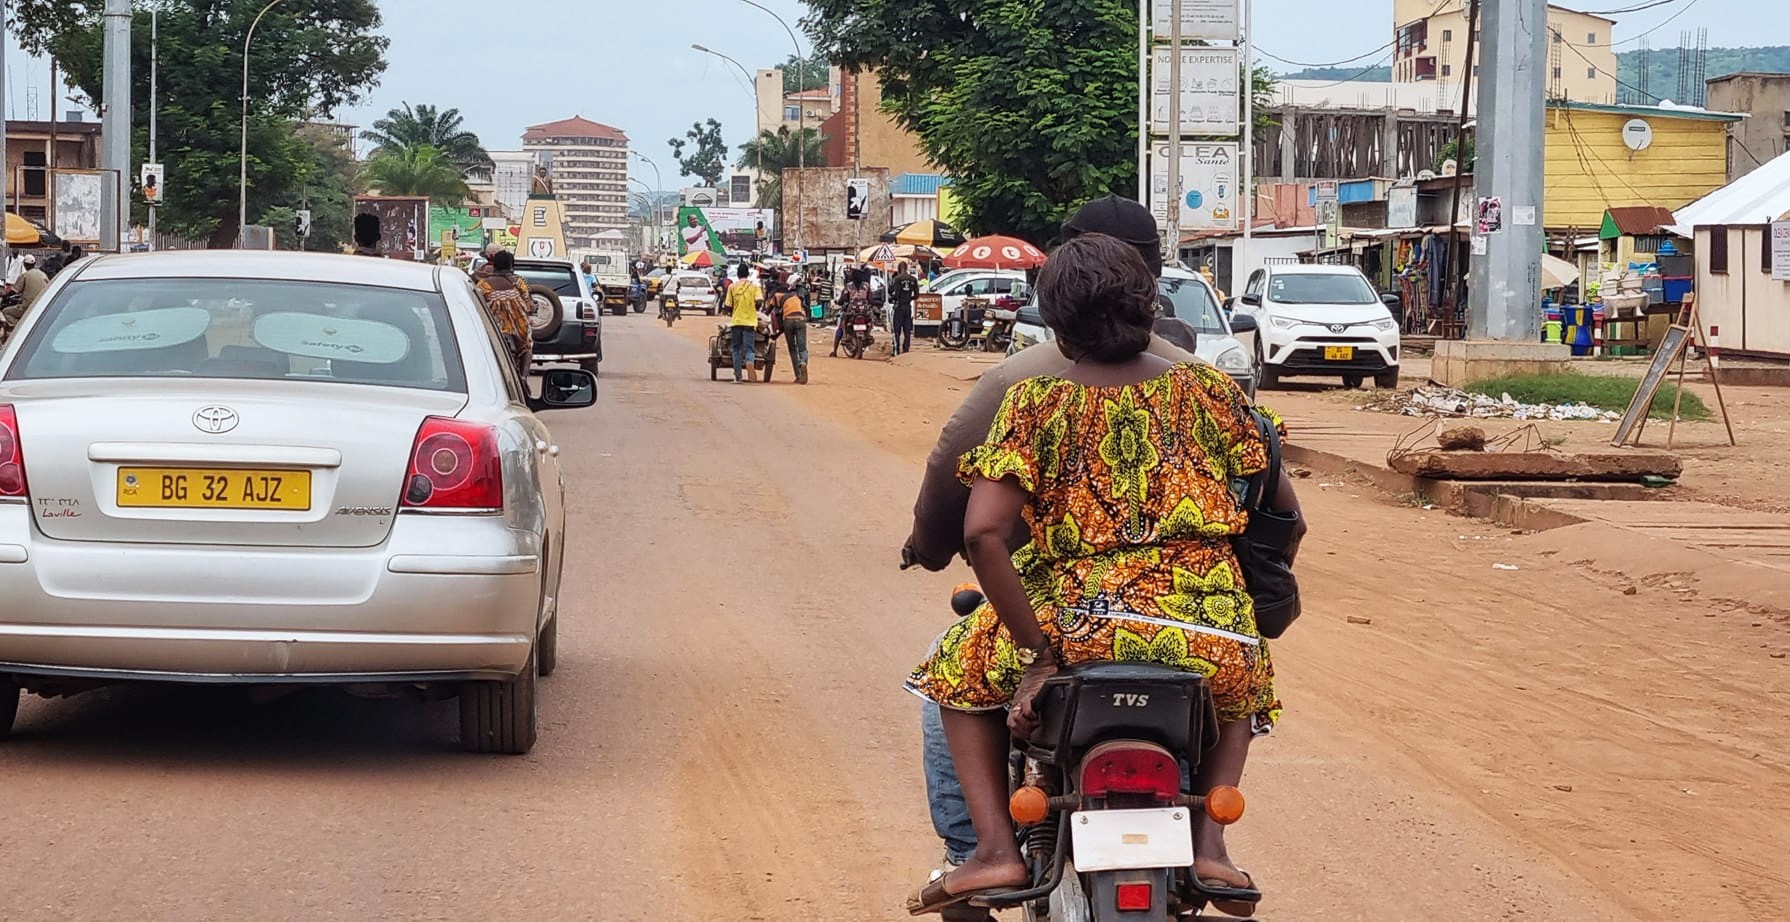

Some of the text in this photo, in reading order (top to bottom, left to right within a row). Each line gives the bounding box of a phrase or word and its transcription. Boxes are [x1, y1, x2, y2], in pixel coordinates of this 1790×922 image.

[1158, 56, 1233, 64] NOE EXPERTISE
[123, 488, 138, 496] RCA
[162, 475, 283, 502] BG 32 AJZ
[43, 508, 83, 518] Laville
[335, 505, 392, 516] AVENSIS
[1113, 693, 1150, 707] TVS
